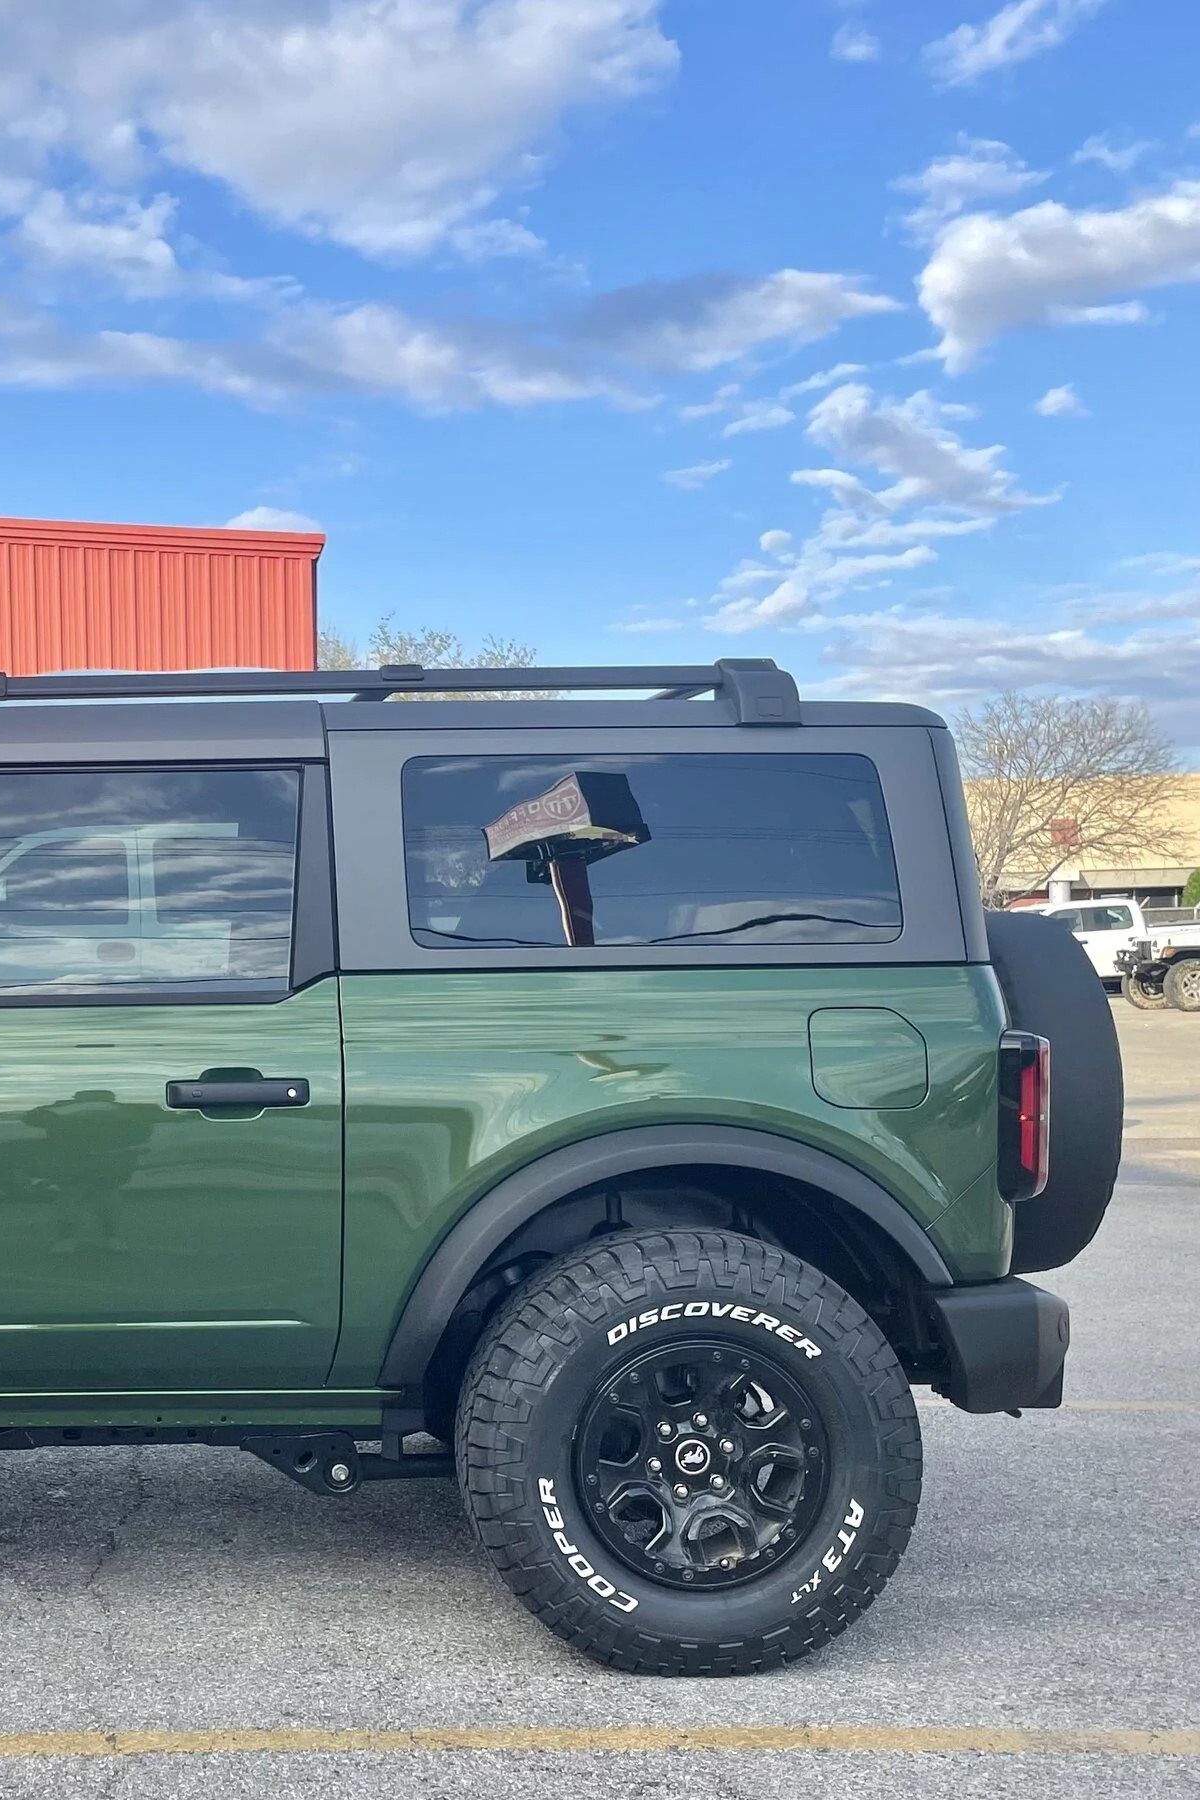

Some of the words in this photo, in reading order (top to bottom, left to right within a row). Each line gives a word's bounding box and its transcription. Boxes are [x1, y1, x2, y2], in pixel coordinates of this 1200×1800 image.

[607, 1301, 822, 1359] DISCOVERER
[538, 1477, 640, 1613] COOPER
[821, 1498, 865, 1573] AT3
[791, 1569, 822, 1604] XLT
